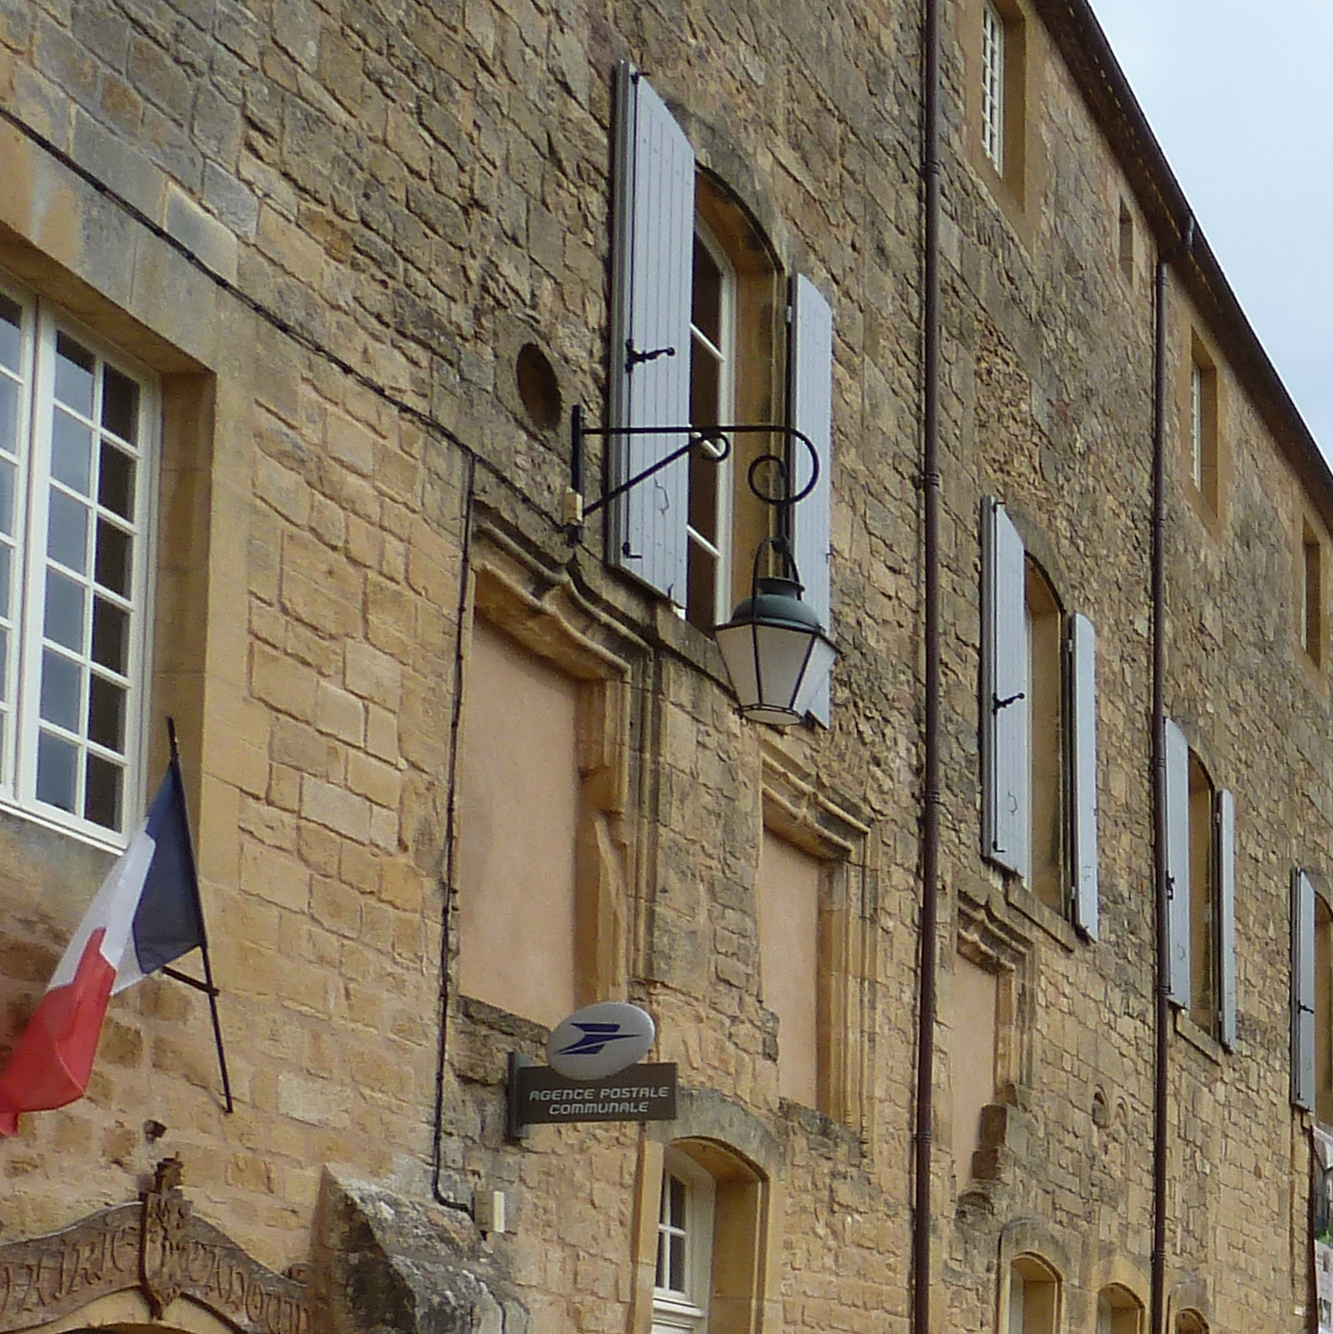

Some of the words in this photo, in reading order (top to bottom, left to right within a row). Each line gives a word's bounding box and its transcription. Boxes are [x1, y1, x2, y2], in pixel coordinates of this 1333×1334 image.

[529, 1089, 595, 1101] AGENCE
[600, 1086, 669, 1099] POSTALE
[549, 1101, 649, 1115] COMMUNALE
